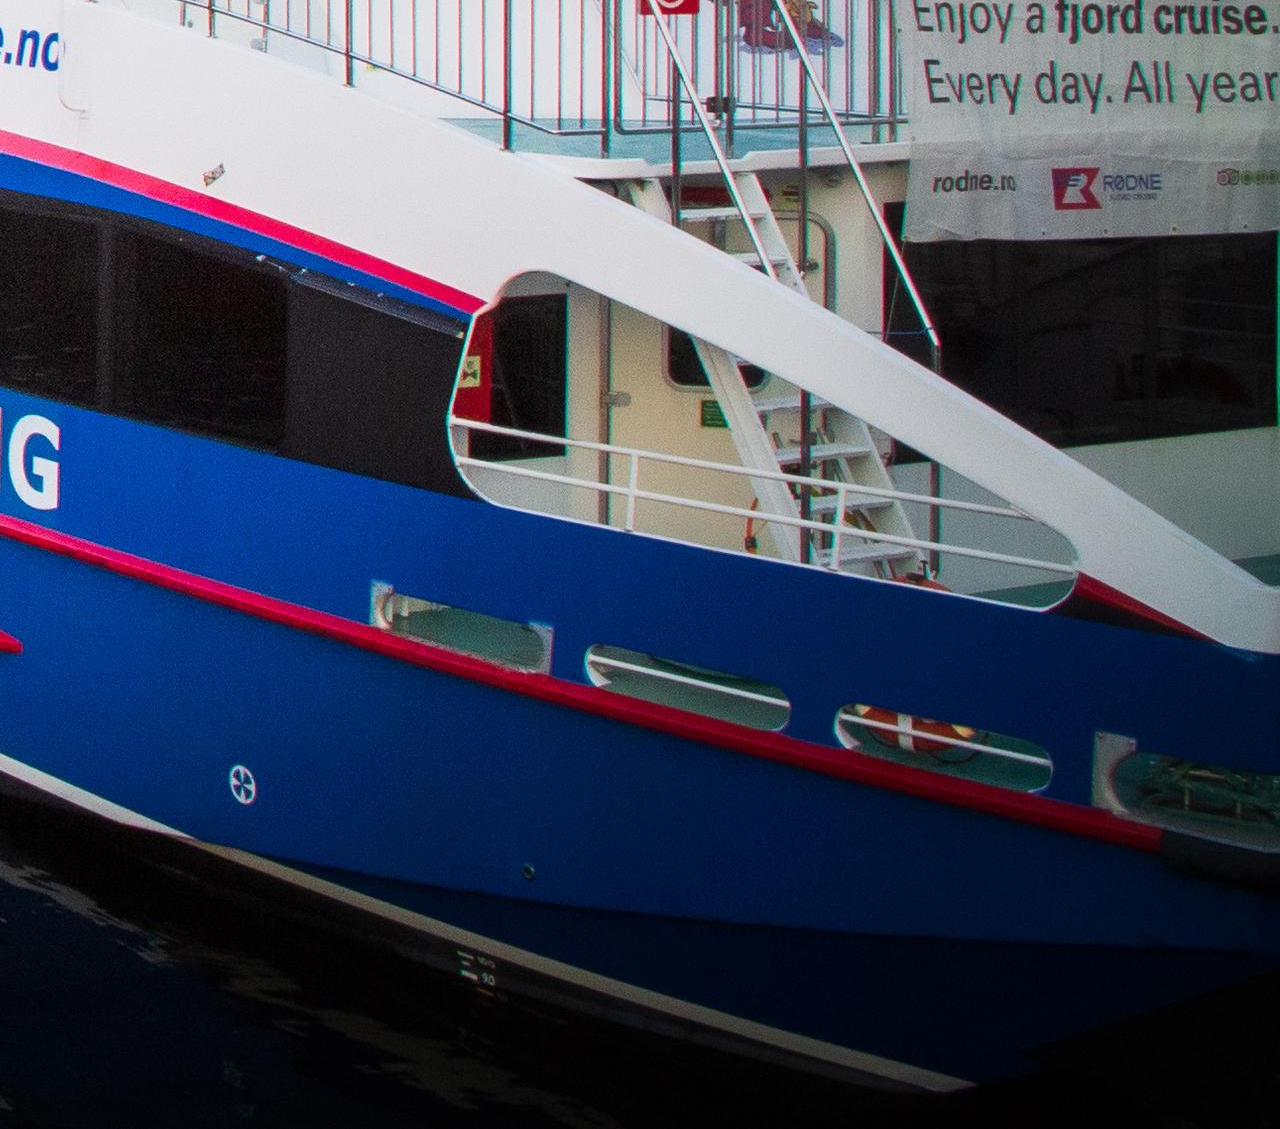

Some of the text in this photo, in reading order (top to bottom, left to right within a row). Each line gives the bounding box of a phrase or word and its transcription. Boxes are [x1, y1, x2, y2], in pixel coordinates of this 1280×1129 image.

[1026, 3, 1044, 33] a
[924, 59, 1278, 115] Every day. All year
[1103, 174, 1162, 192] RØDNE
